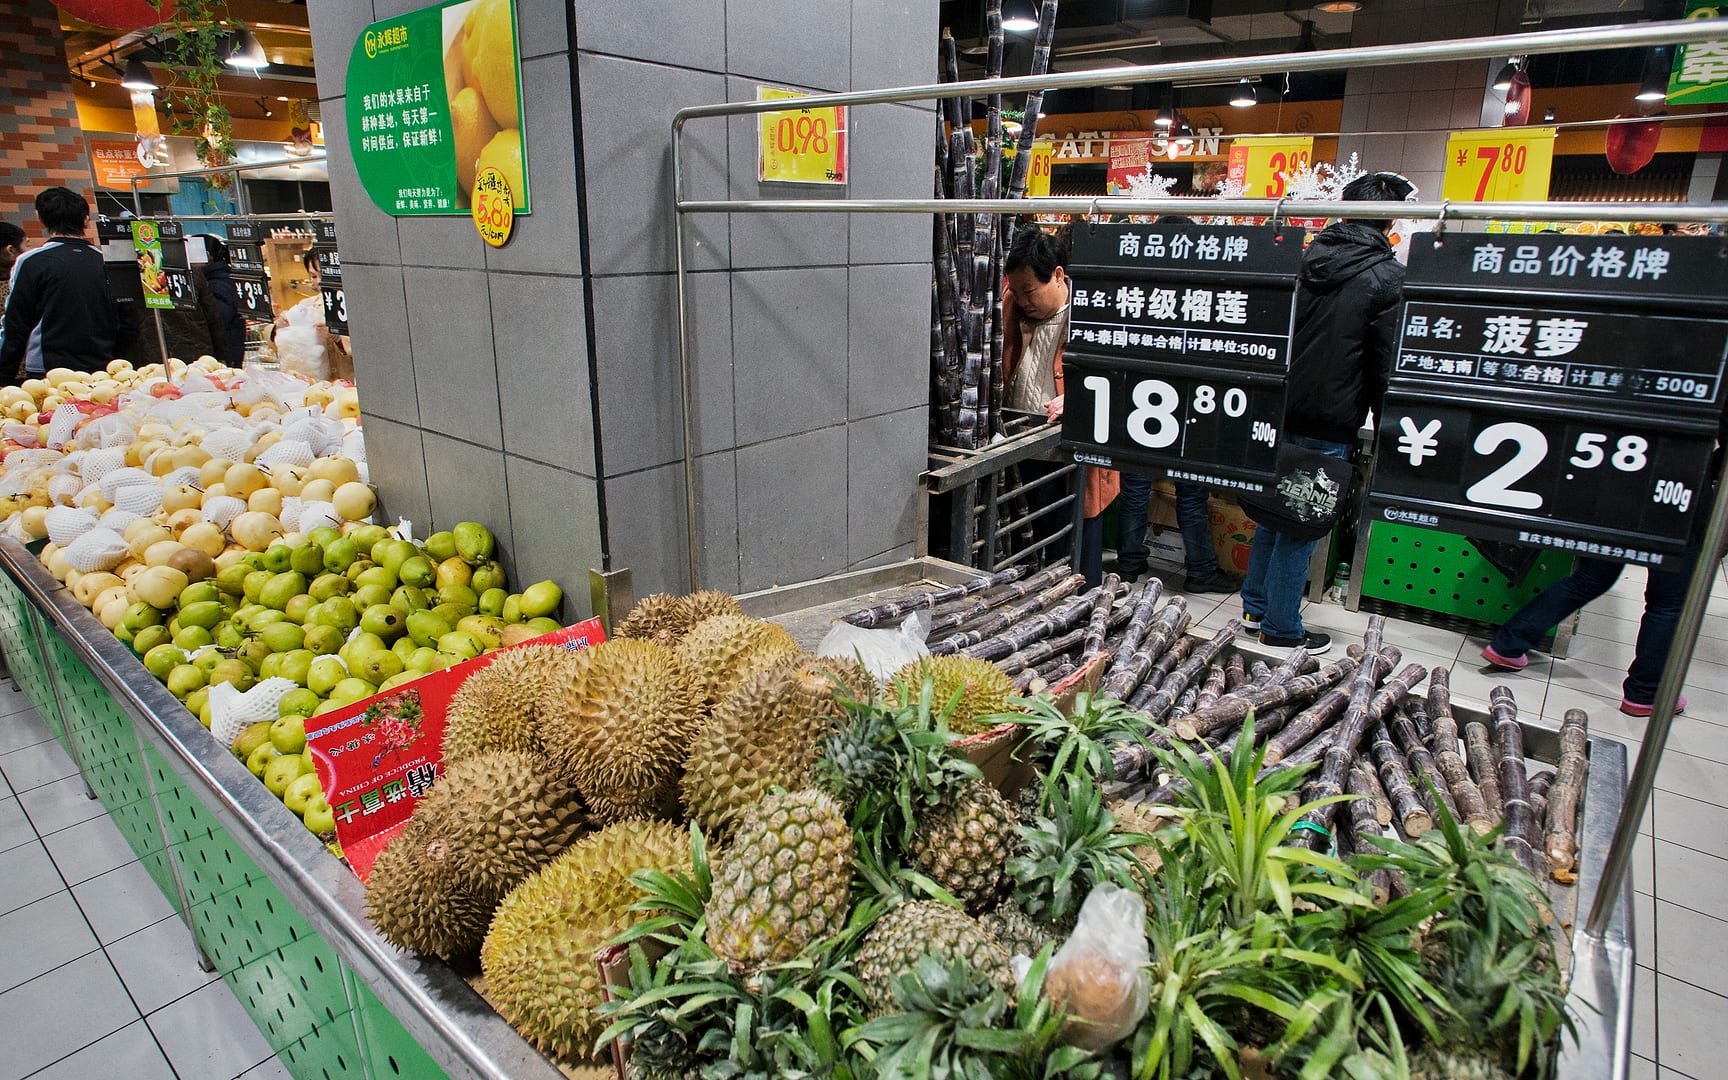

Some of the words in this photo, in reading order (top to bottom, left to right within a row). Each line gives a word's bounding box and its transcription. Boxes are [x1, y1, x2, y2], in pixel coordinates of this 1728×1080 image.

[377, 25, 407, 48] 永辉超市
[363, 84, 430, 110] 我们的水果来自于
[777, 116, 829, 155] 0.98
[477, 194, 511, 227] 5.80
[1119, 232, 1249, 262] 商品价格牌
[1472, 243, 1670, 280] 商品价格牌
[1115, 286, 1249, 324] 特级榴莲
[1481, 315, 1589, 357] 菠萝
[1252, 421, 1277, 448] 500g
[1653, 479, 1692, 512] 500g
[376, 770, 391, 781] OF
[392, 755, 427, 775] PRODUCE
[335, 761, 438, 825] 精选富士
[339, 779, 375, 796] CHINA
